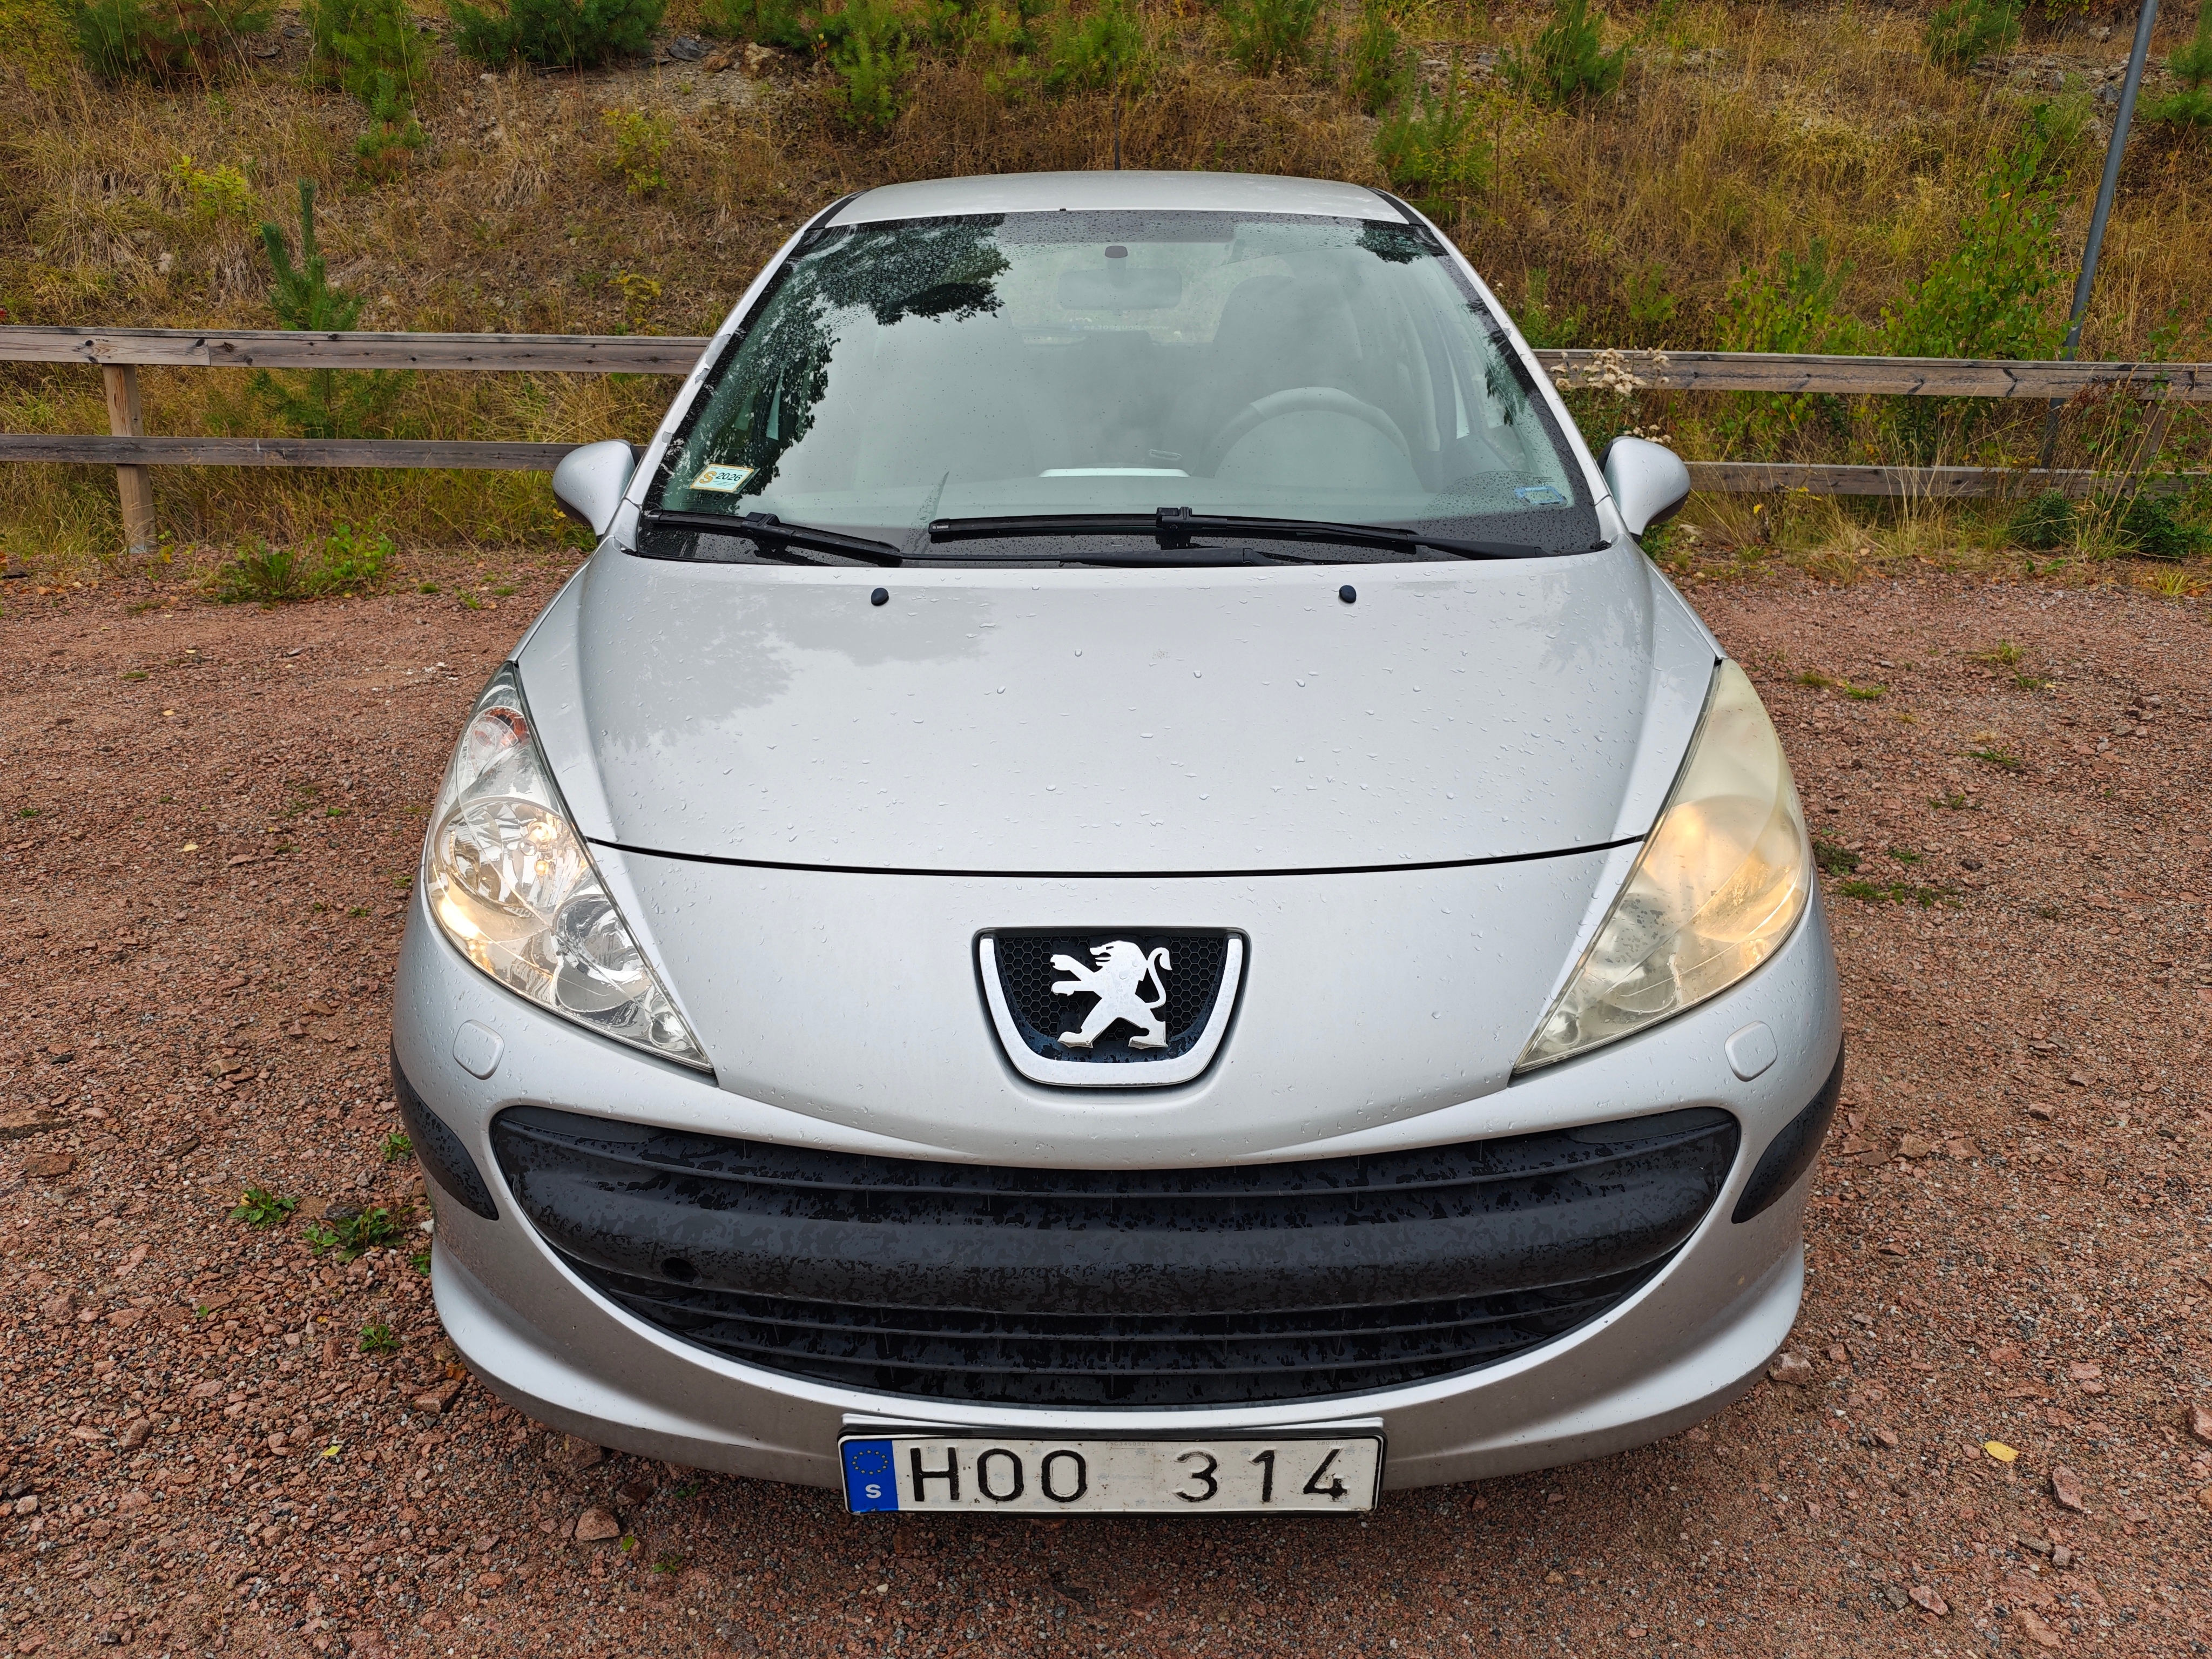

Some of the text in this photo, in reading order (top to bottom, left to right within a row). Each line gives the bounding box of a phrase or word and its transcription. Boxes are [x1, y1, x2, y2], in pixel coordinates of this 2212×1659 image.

[715, 472, 743, 481] 2026
[909, 1447, 1350, 1502] HOO 314
[865, 1483, 882, 1499] S
